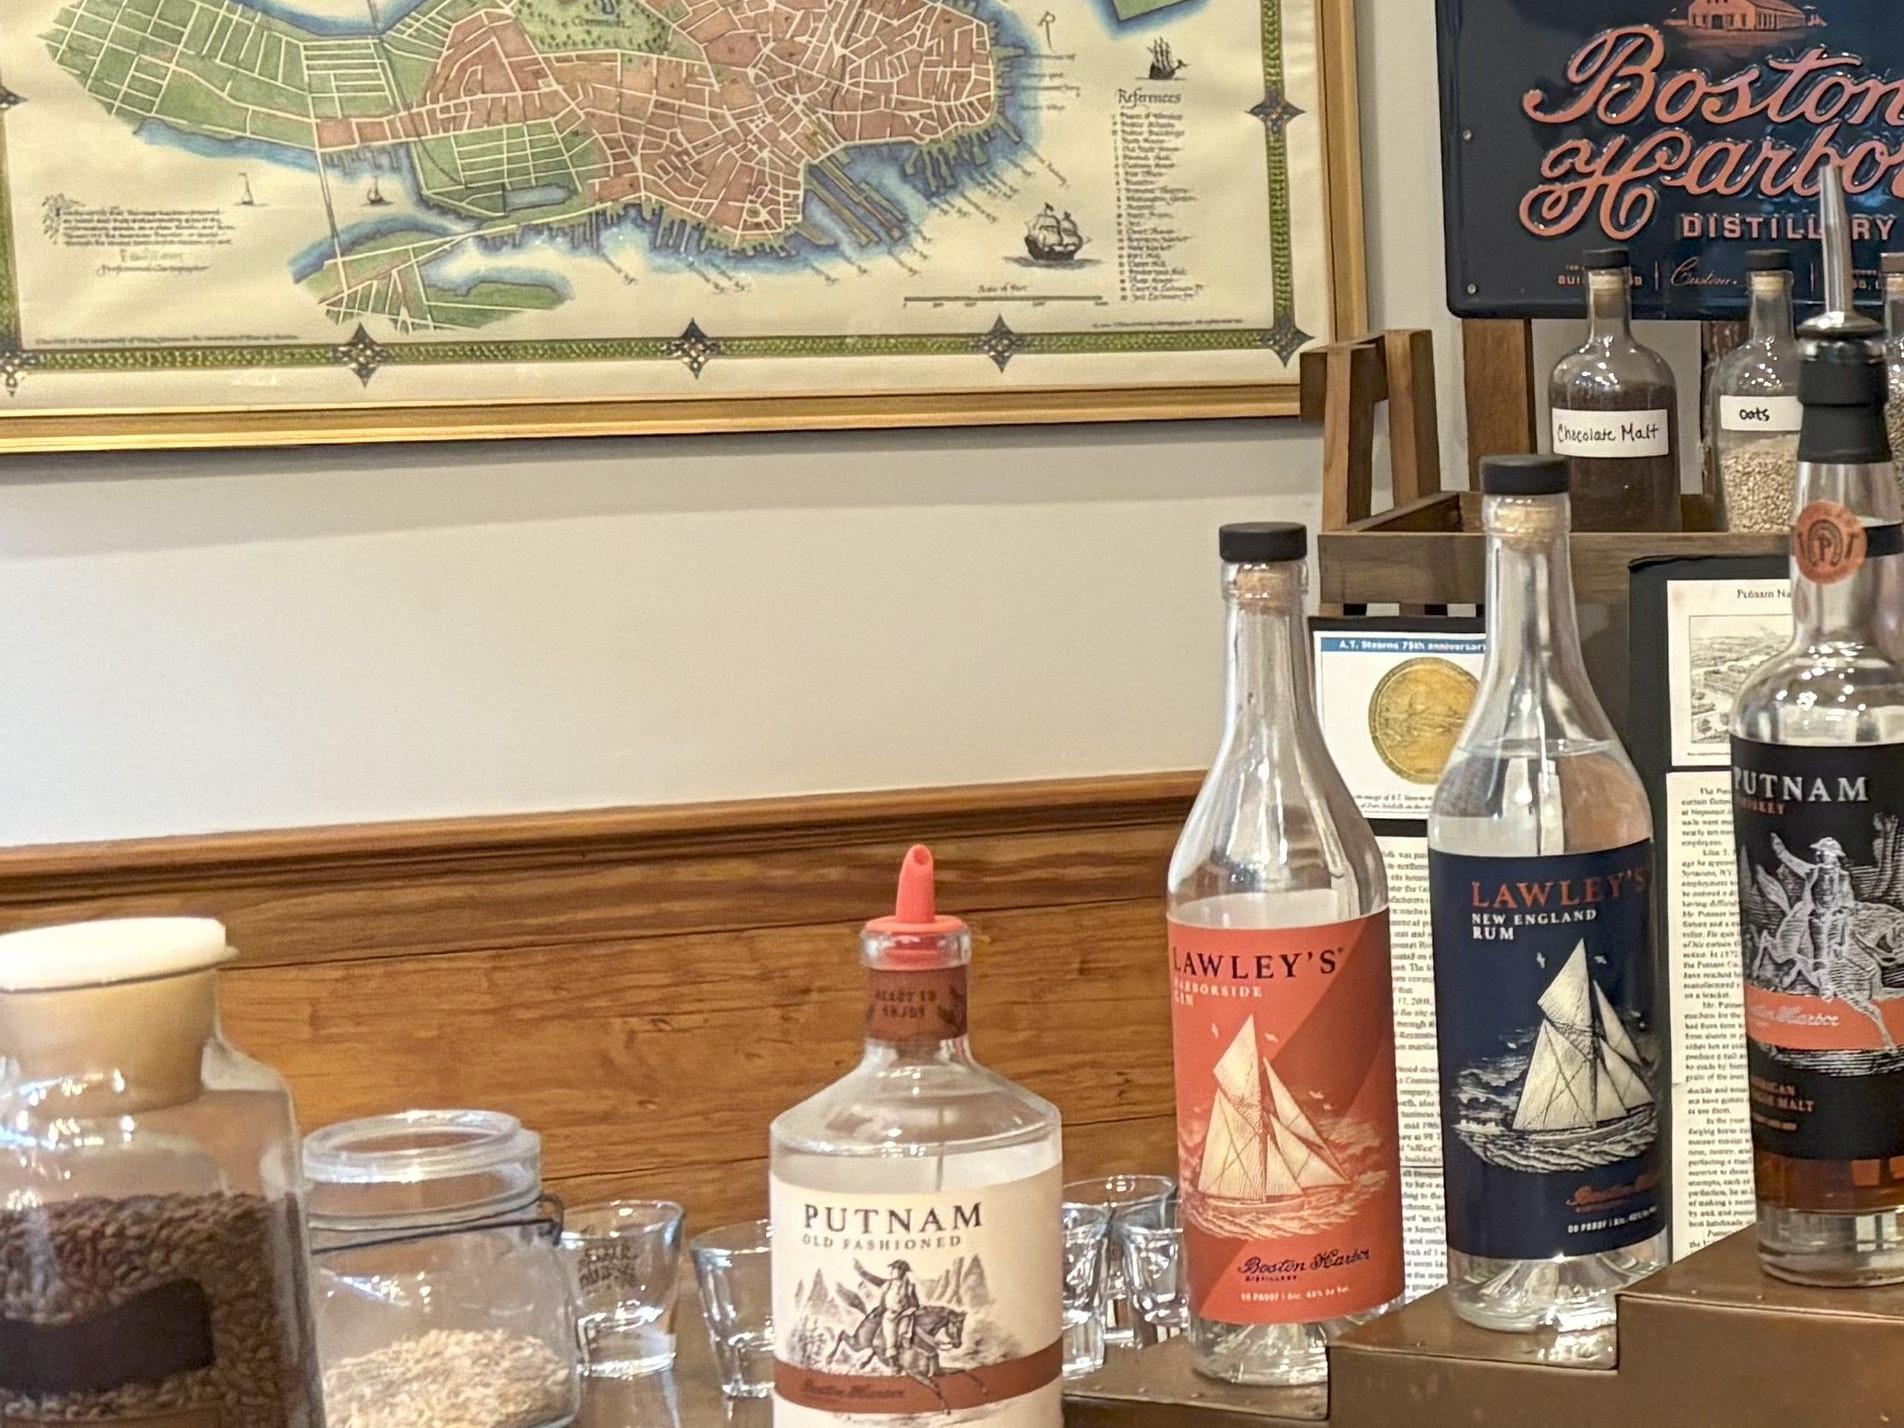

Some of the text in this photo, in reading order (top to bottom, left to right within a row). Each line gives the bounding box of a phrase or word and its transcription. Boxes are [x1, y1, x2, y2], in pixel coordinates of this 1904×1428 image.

[1117, 86, 1183, 110] References
[1681, 213, 1897, 241] DISTILLRY
[1738, 408, 1770, 422] oats
[1556, 422, 1660, 443] Chocolate Malt
[1732, 765, 1870, 803] PUTNAM
[1471, 908, 1597, 926] NEW ENGLAND
[1472, 925, 1515, 941] RUM
[803, 1201, 984, 1235] PUTNAM
[802, 1233, 962, 1252] OLD FASHIONED
[1237, 1248, 1370, 1275] Boston Harbor
